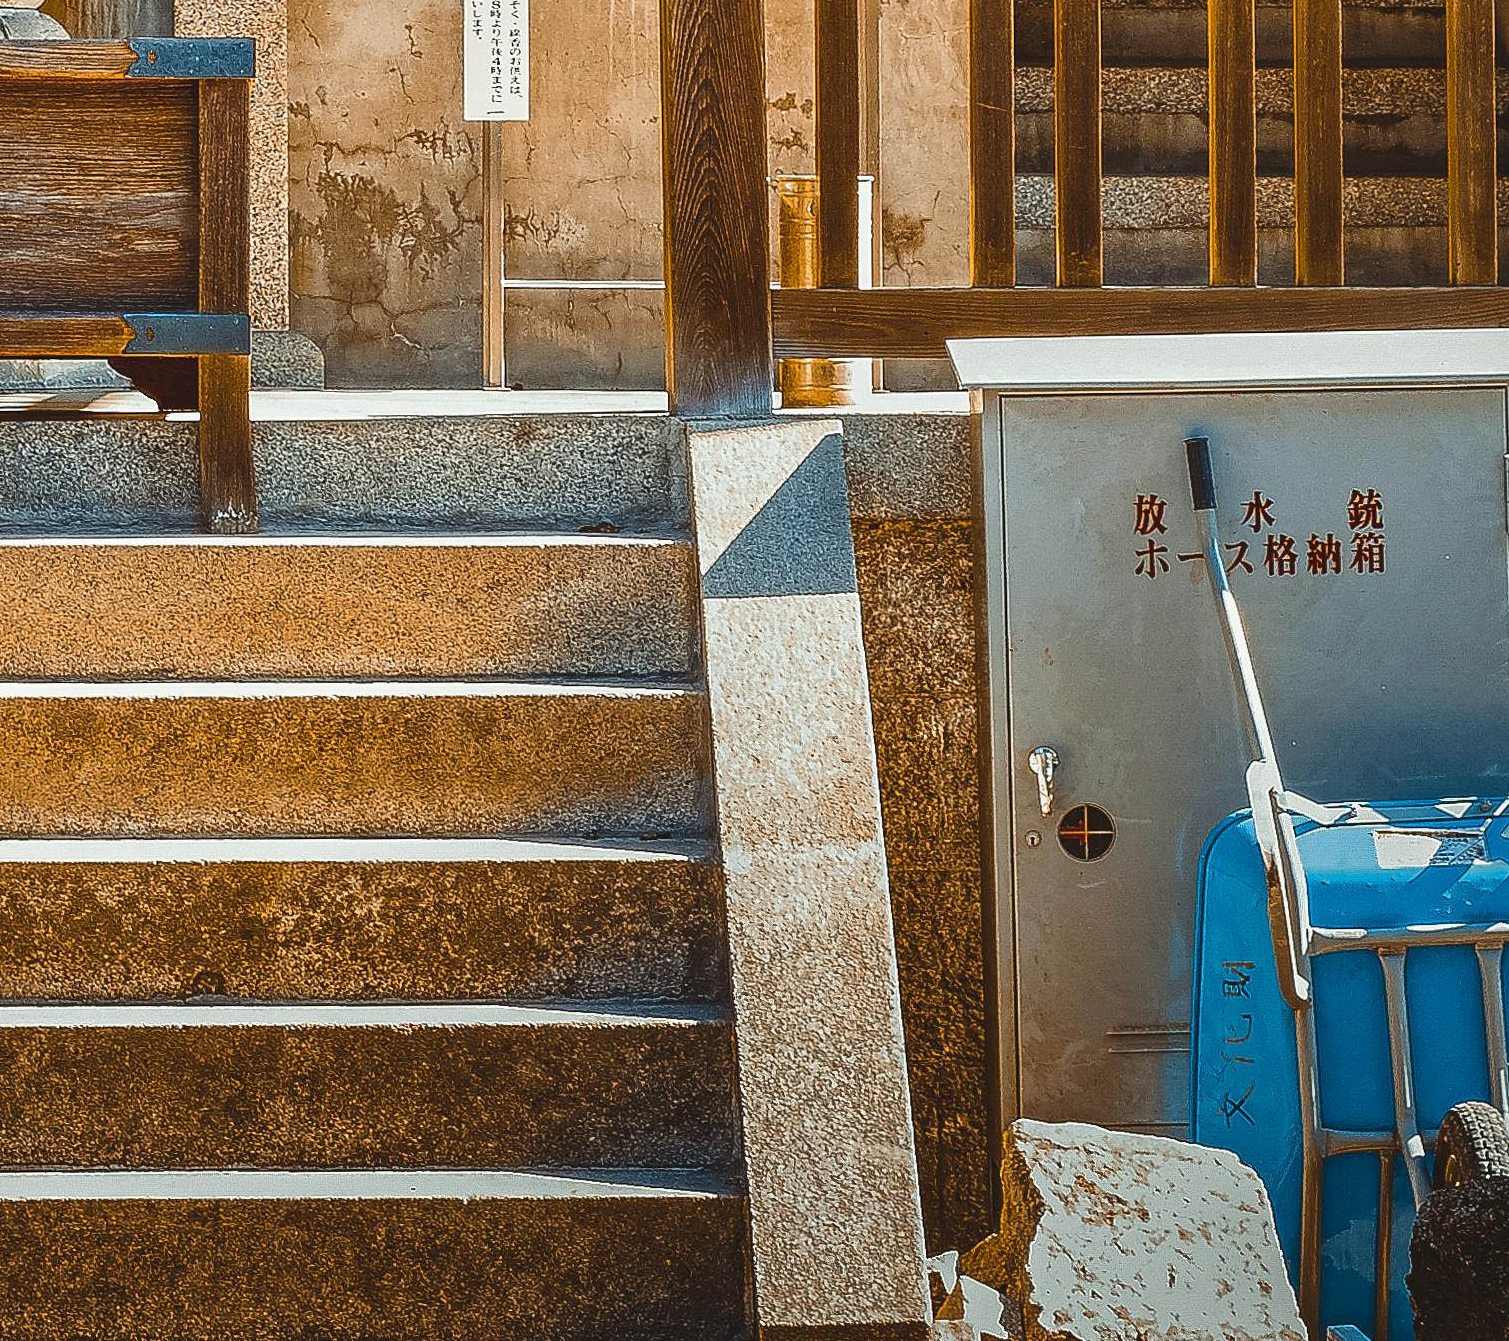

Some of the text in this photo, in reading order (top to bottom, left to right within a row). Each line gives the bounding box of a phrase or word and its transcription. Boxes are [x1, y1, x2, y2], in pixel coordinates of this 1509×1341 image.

[1134, 532, 1386, 579] ホース格納箱
